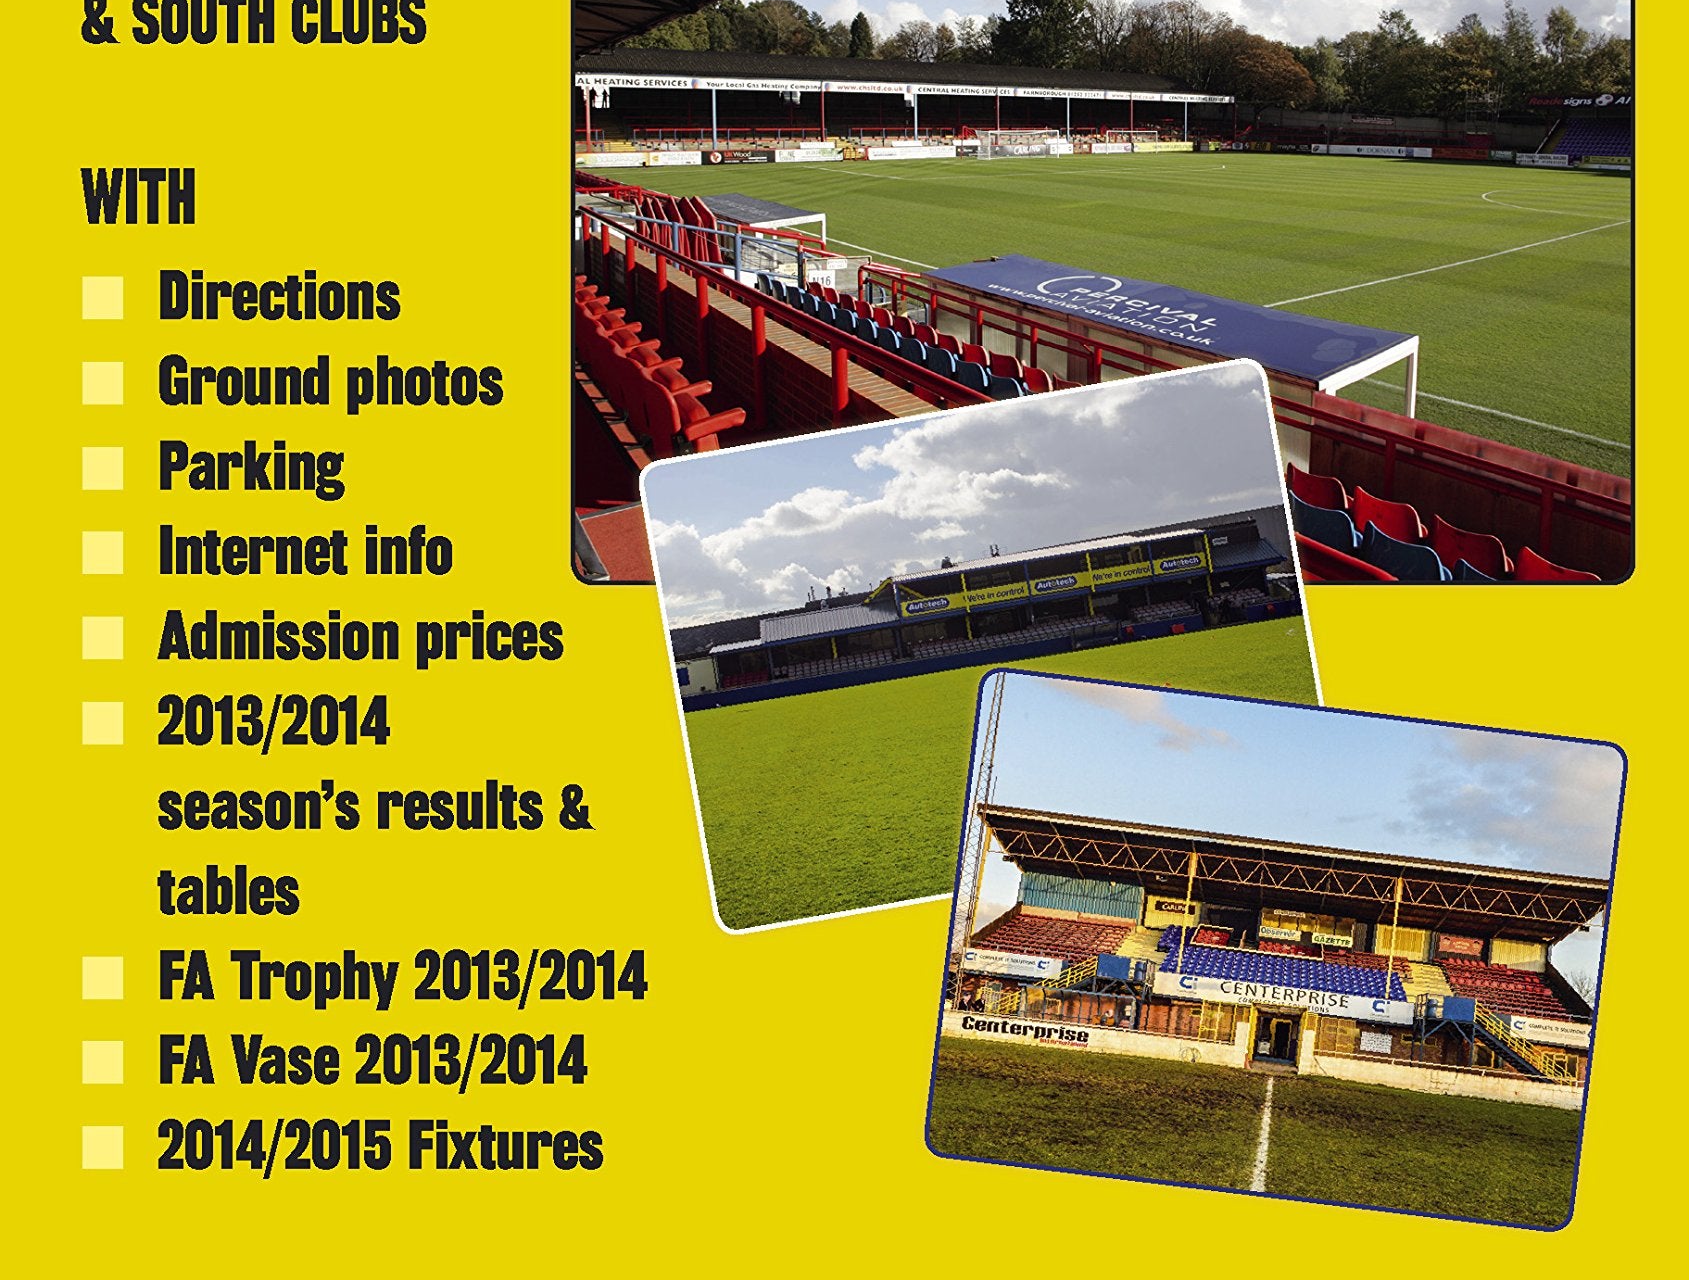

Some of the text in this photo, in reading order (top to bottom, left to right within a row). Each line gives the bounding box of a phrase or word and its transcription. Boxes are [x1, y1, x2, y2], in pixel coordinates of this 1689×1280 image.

[594, 77, 640, 86] HEATING
[643, 79, 688, 87] SERVICES
[761, 82, 788, 91] Heating
[790, 84, 822, 92] Company
[917, 86, 950, 94] CENTRAL
[981, 88, 1011, 96] SERVCES
[81, 168, 195, 224] WITH
[159, 270, 401, 321] Directions
[1049, 291, 1209, 334] AVIATION
[1069, 287, 1218, 328] PERCIVAL
[159, 354, 504, 416] Ground photos
[159, 441, 346, 502] Parking
[159, 524, 453, 576] Internet info
[1161, 555, 1200, 570] Autotech
[986, 591, 996, 599] in
[996, 586, 1025, 598] control
[1036, 577, 1076, 591] Autotech
[1113, 568, 1122, 578] in
[1122, 566, 1151, 577] control
[907, 598, 948, 611] Autotech
[158, 609, 564, 670] Admission prices
[158, 694, 391, 756] 2013/2014
[158, 779, 597, 831] season's results &
[158, 864, 300, 916] tables
[1161, 902, 1190, 912] CARLIN
[1313, 935, 1351, 947] GAZETTE
[159, 949, 649, 1011] FA Trophy 2013/2014
[1220, 980, 1350, 1010] CENTERPRISE
[961, 1015, 1090, 1043] Centerprise
[159, 1034, 588, 1095] FA Vase 2013/2014
[158, 1119, 604, 1180] 2014/2015 Fixtures
